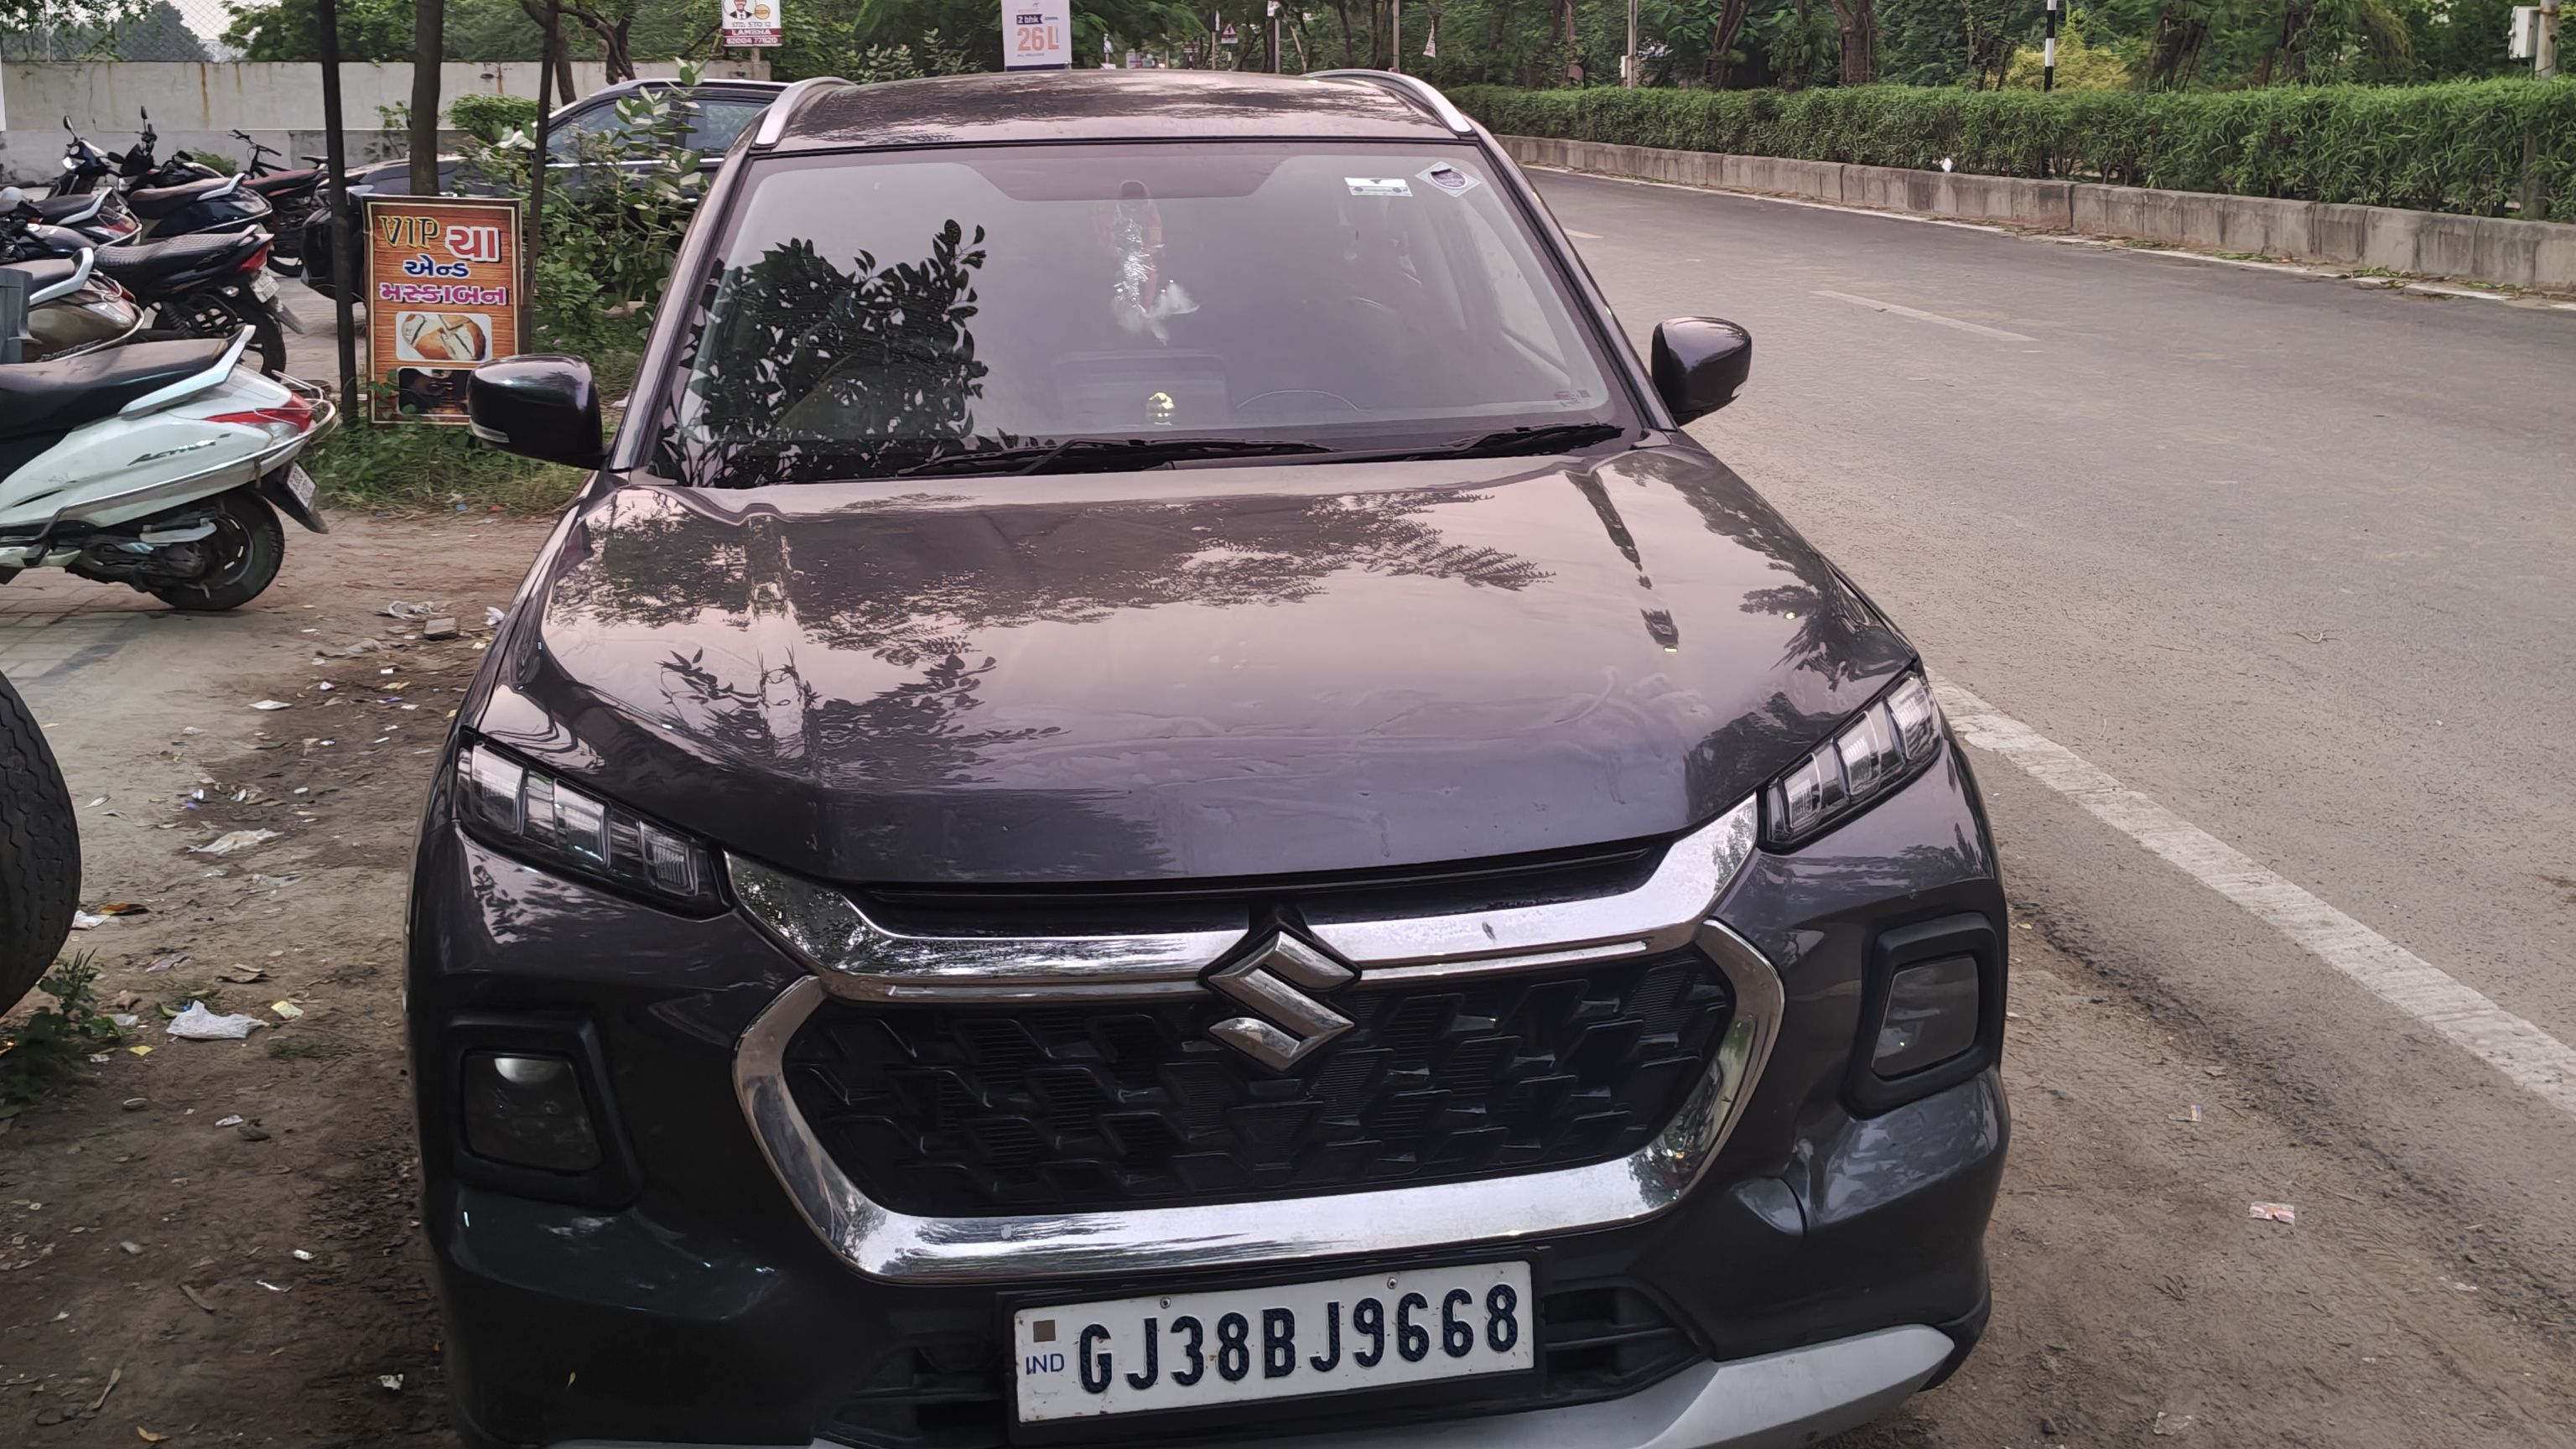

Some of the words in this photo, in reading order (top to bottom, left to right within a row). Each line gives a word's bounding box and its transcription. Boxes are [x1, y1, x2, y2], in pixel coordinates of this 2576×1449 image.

[379, 216, 439, 249] VIP
[445, 226, 500, 262] ચા
[403, 254, 471, 278] એન્ડ
[1078, 1284, 1519, 1394] GJ38BJ9668
[1026, 1353, 1065, 1375] IND
